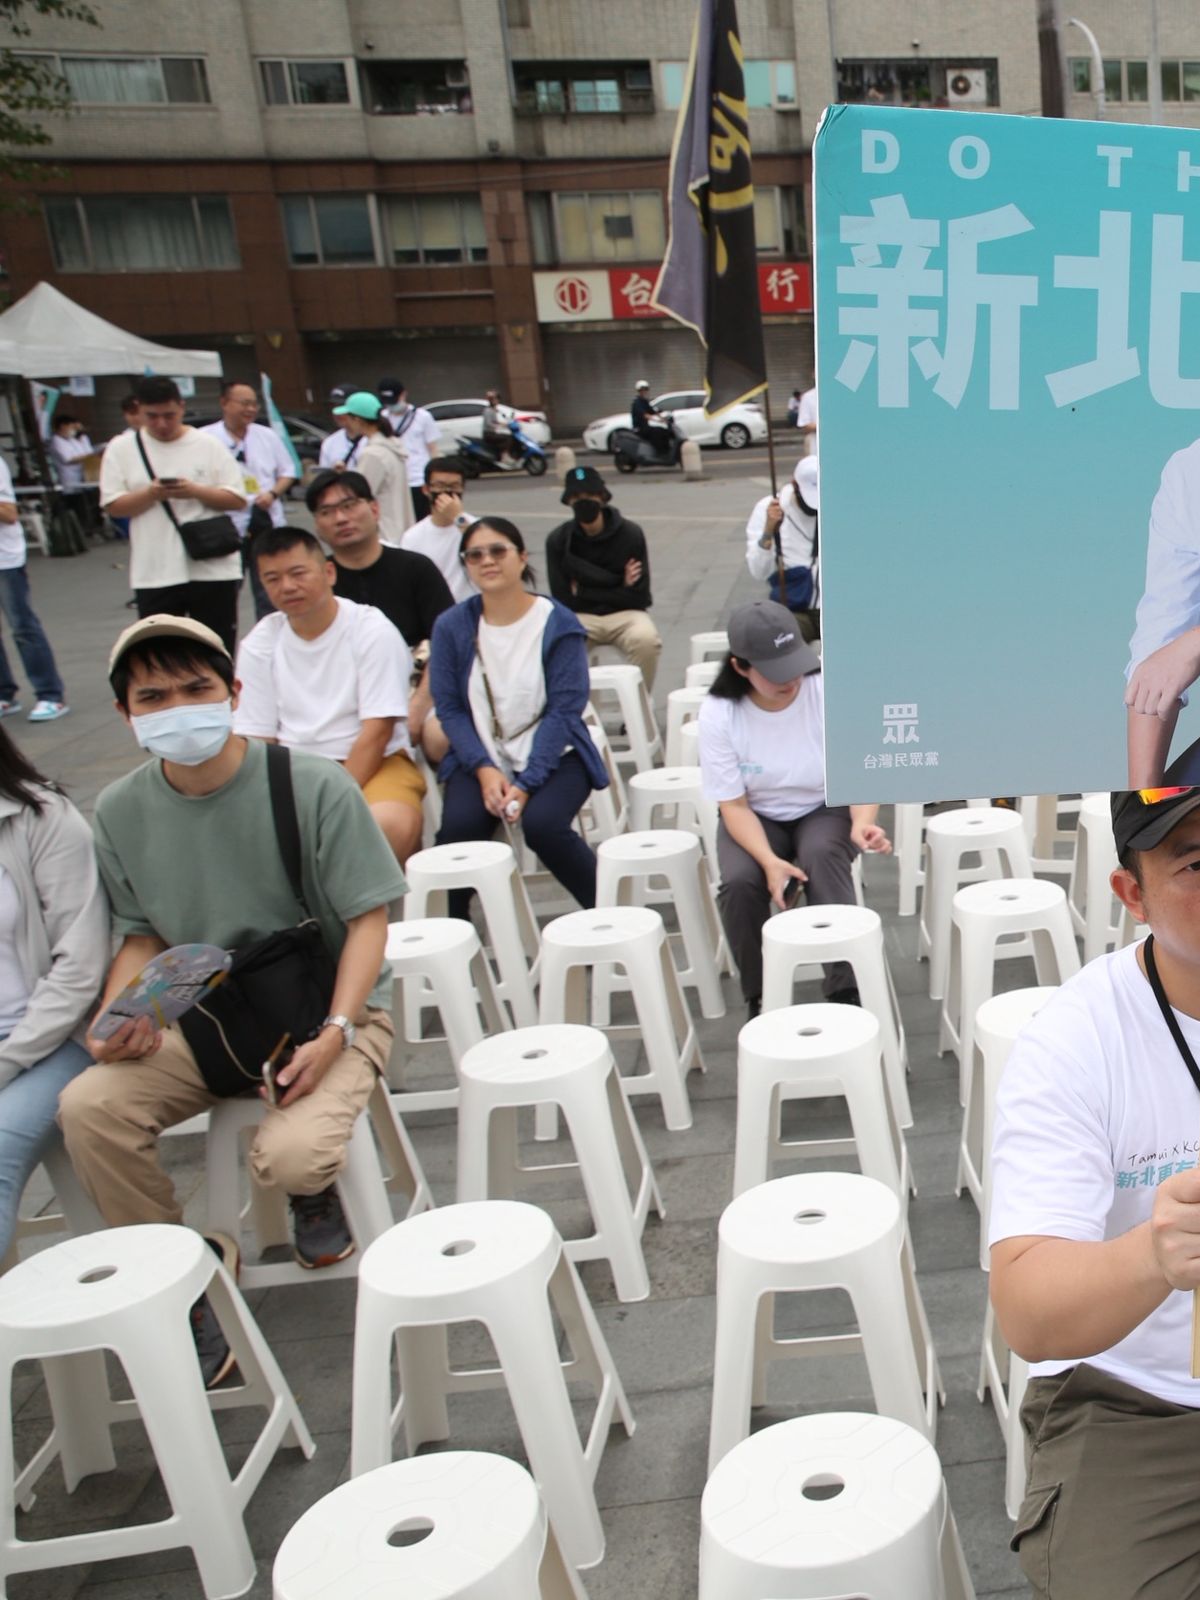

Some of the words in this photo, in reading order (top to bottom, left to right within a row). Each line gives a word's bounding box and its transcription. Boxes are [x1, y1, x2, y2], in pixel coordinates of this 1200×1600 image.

[860, 129, 991, 180] DO
[863, 751, 940, 769] 台灣民眾黨
